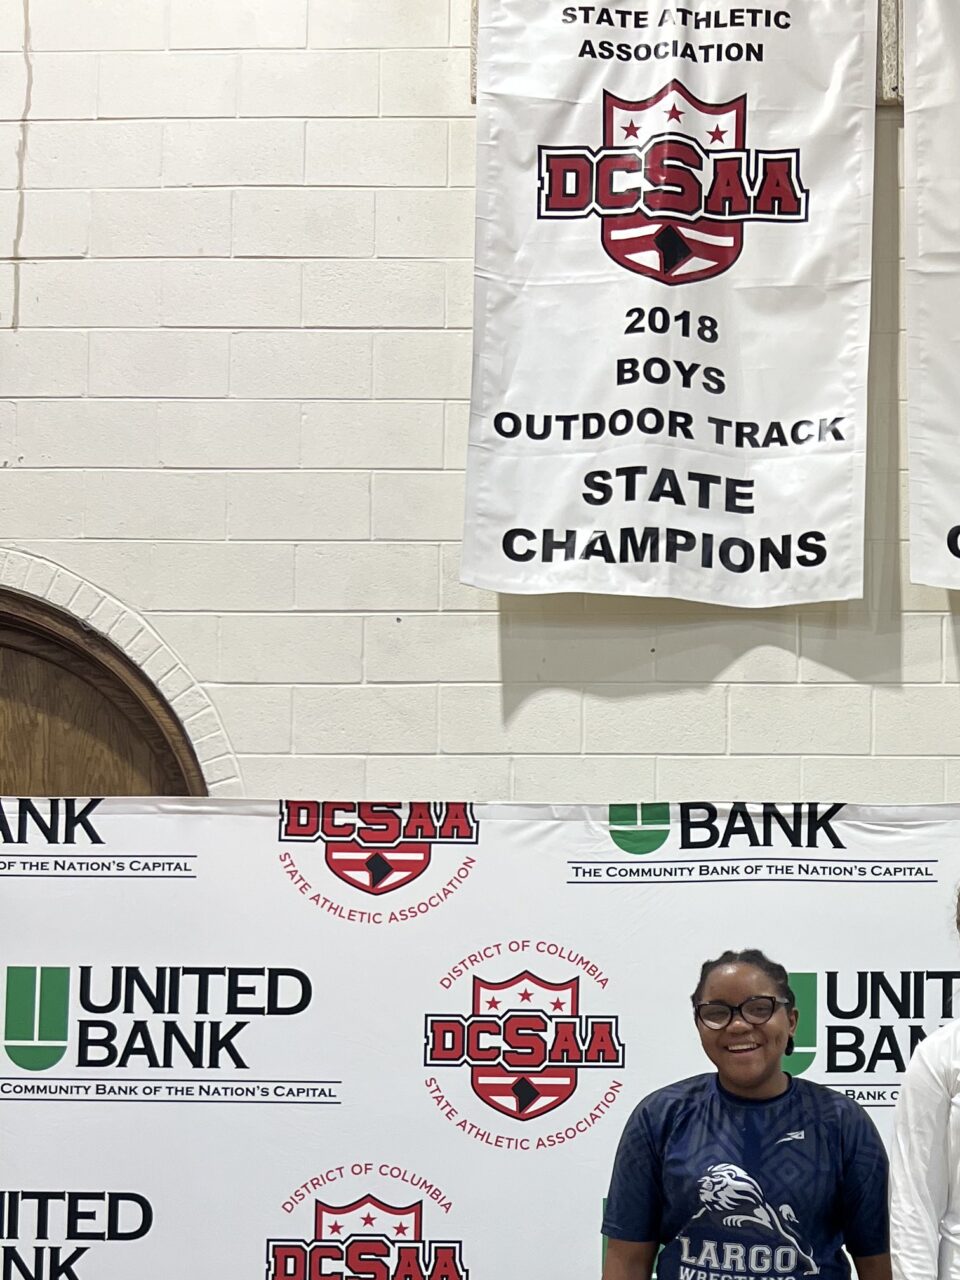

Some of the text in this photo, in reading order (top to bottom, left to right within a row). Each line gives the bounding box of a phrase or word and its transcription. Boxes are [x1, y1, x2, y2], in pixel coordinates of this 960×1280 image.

[563, 7, 790, 29] STATE ATHLETIC
[579, 40, 763, 62] ASSOCIATION
[537, 133, 809, 222] DCSAA
[625, 307, 718, 343] 2018
[617, 358, 725, 394] BOYS
[494, 408, 844, 447] OUTDOOR TRACK
[582, 466, 754, 514] STATE
[503, 527, 826, 573] CHAMPIONS
[278, 799, 479, 846] DCSAA
[678, 802, 847, 849] BANK
[278, 851, 477, 924] STATE ATHLETIC ASSOCIATION
[572, 867, 601, 877] THE
[606, 867, 694, 877] COMMUNITY
[699, 865, 739, 875] BANK
[744, 865, 763, 874] OF
[766, 865, 793, 874] THE
[871, 866, 933, 876] CAPITAL
[438, 939, 609, 991] DISTRICT OF COLUMBIA
[79, 966, 312, 1015] UNITED
[76, 1020, 250, 1069] BANK
[424, 1008, 625, 1071] DCSAA
[1, 1083, 91, 1094] COMMUNITY
[96, 1084, 138, 1095] BANK
[143, 1086, 162, 1095] OF
[166, 1087, 194, 1095] THE
[274, 1086, 336, 1097] CAPITAL
[425, 1077, 623, 1151] STATE ATHLETIC ASSOCIATION
[282, 1163, 453, 1214] DISTRICT OF COLUMBIA
[0, 1191, 152, 1241] ITED
[679, 1237, 797, 1273] LARGO
